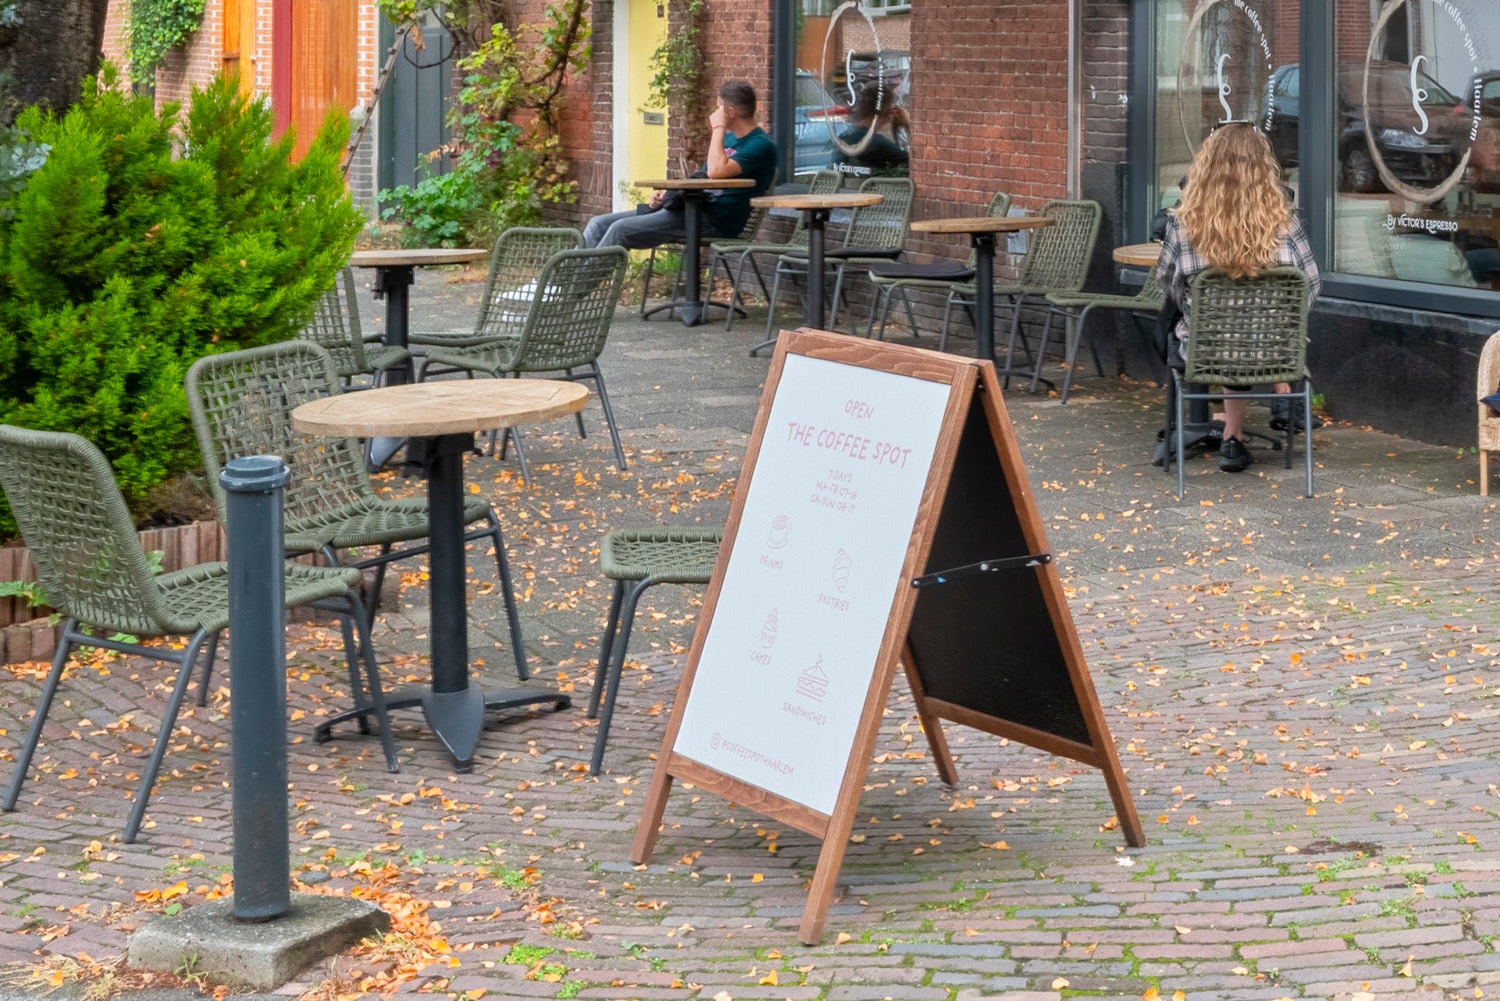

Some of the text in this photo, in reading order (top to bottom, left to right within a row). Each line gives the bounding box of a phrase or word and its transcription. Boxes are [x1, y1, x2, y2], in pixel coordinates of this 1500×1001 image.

[1244, 5, 1263, 34] coffee
[1444, 1, 1466, 33] coffee
[1260, 33, 1271, 59] spot
[1464, 33, 1478, 61] spot
[1264, 74, 1275, 132] Haarlem
[1469, 78, 1483, 141] Haarlem
[1425, 219, 1458, 234] ESPRESSO
[844, 399, 875, 418] OPEN
[787, 422, 912, 469] THE COFFEE SPOT
[817, 592, 850, 611] PASTRIES
[782, 701, 828, 726] SANDWICHES
